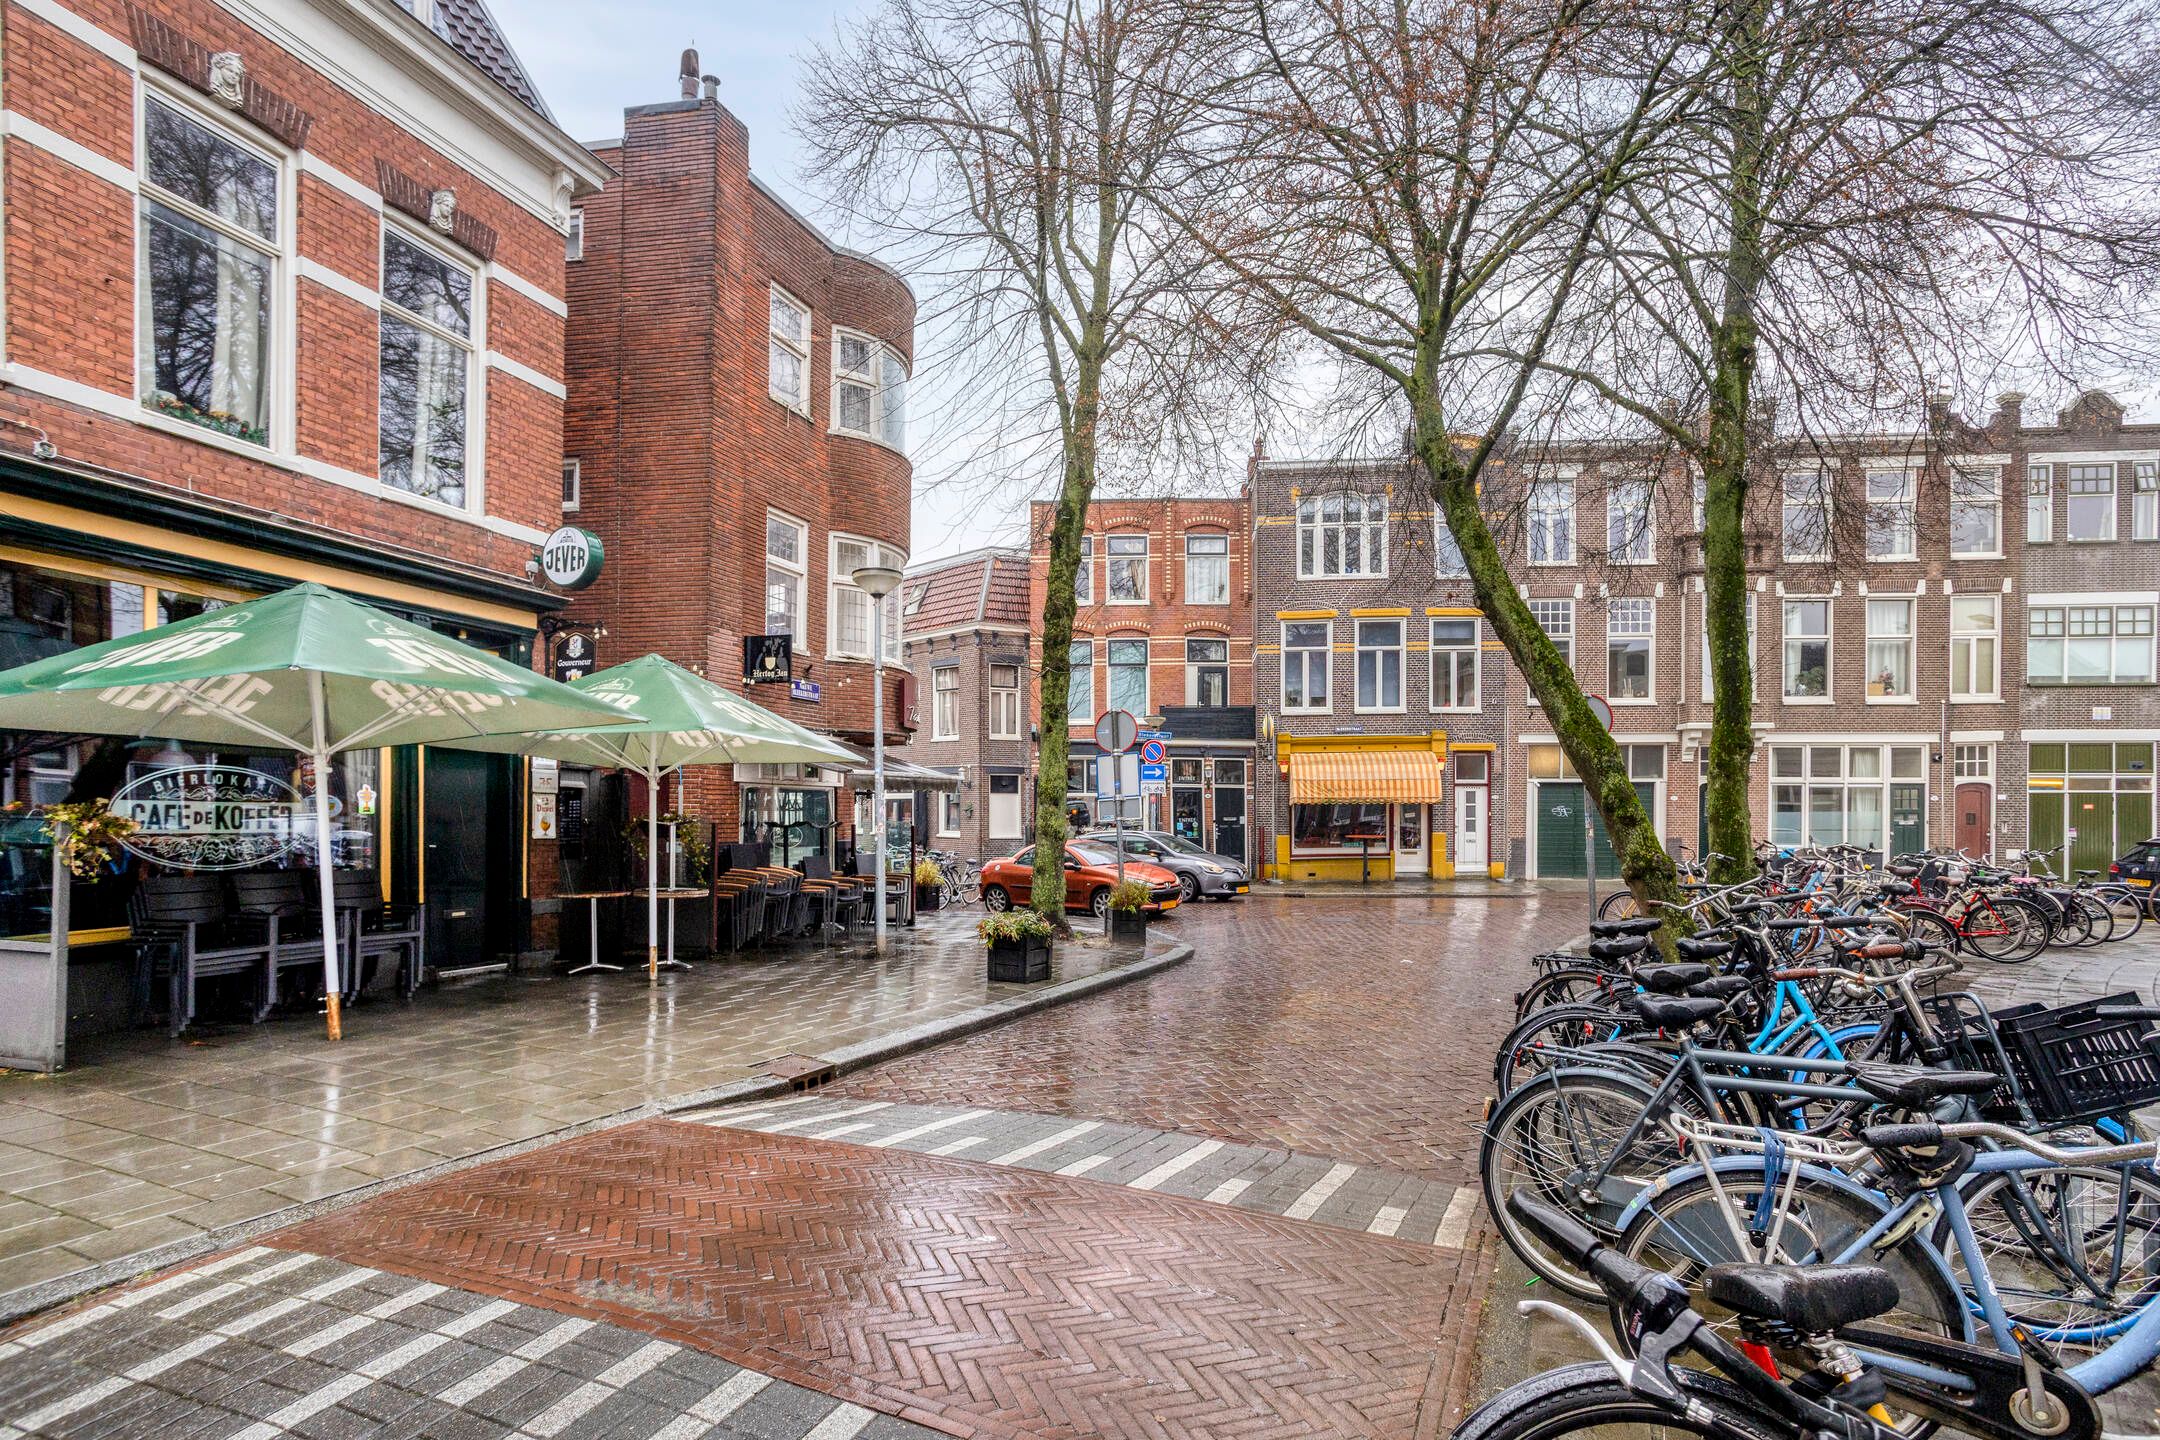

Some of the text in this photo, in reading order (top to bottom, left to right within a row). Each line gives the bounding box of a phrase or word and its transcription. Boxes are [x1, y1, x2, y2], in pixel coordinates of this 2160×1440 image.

[546, 545, 585, 573] JEVER
[557, 659, 592, 667] Gouverneur
[752, 668, 788, 678] Hertog Jan
[153, 773, 275, 794] BIERLOKAAL
[193, 811, 212, 825] DE
